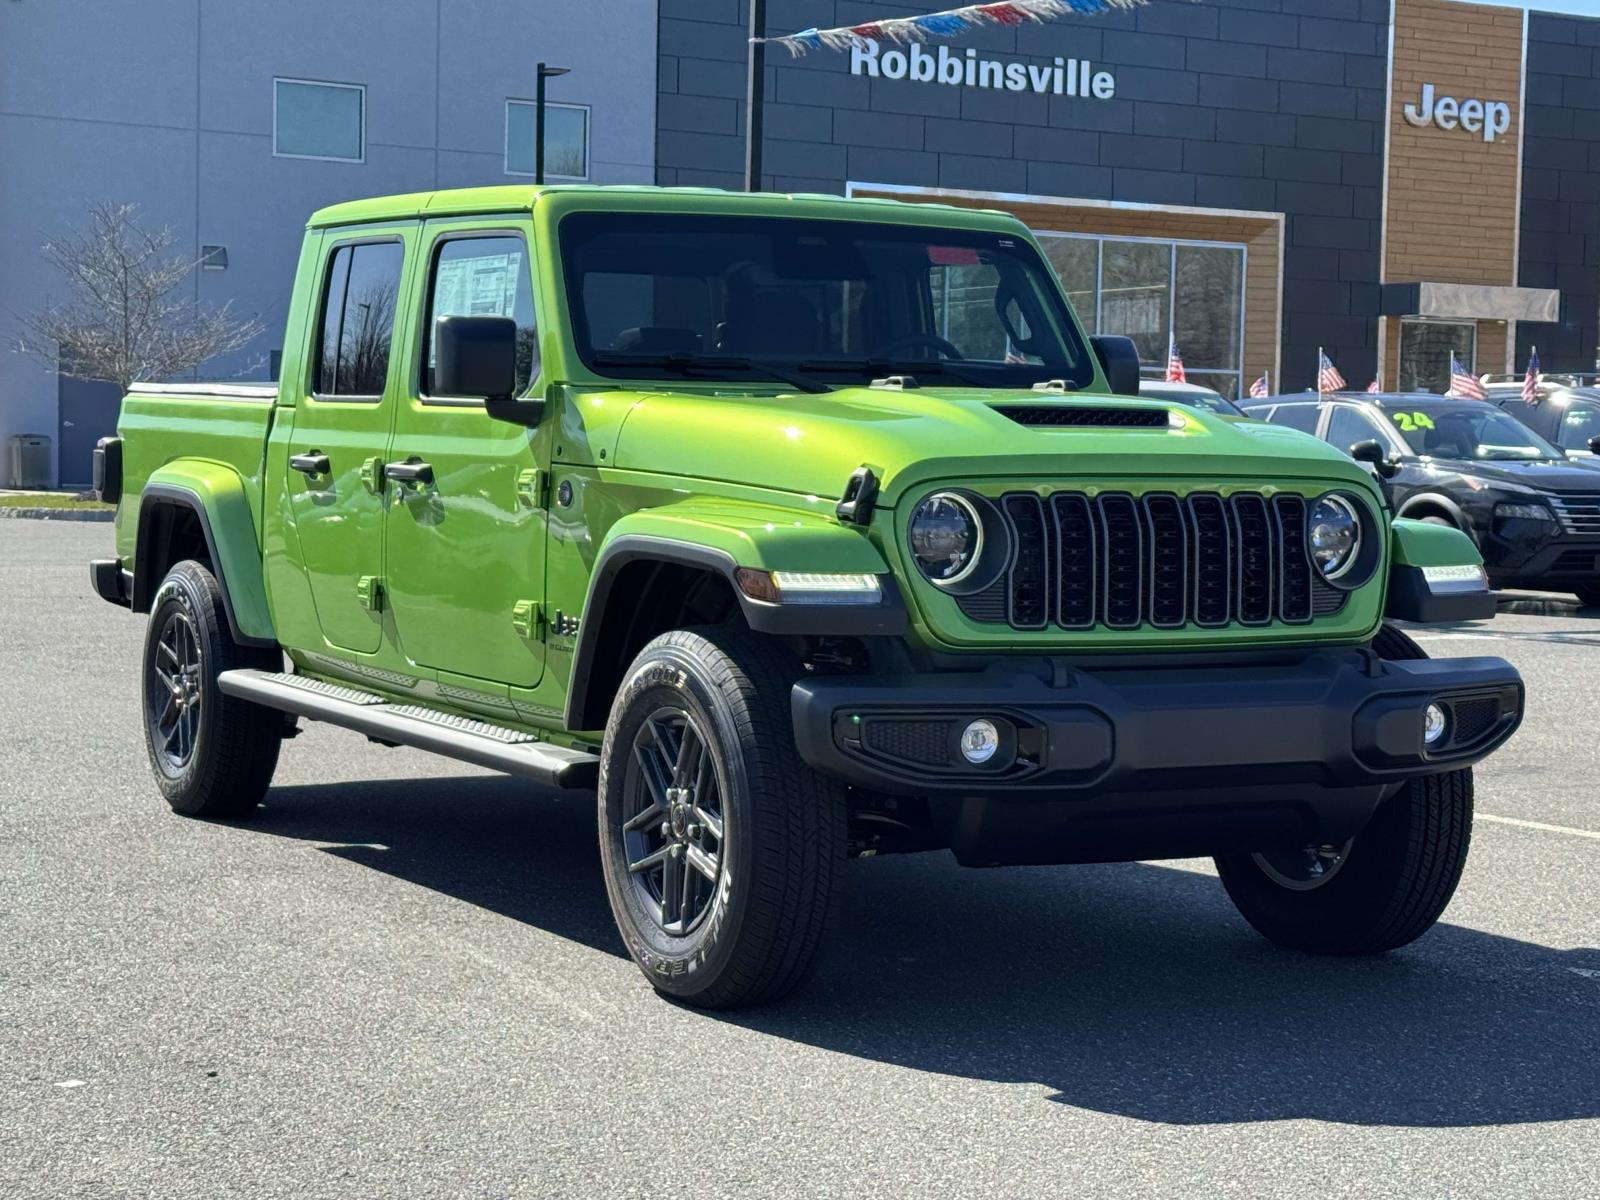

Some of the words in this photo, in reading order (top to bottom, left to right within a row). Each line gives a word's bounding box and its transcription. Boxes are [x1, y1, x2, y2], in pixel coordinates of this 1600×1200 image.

[850, 36, 1115, 100] Robbinsville
[1403, 83, 1511, 143] Jeep
[1392, 411, 1436, 431] 24
[550, 608, 581, 637] Jee
